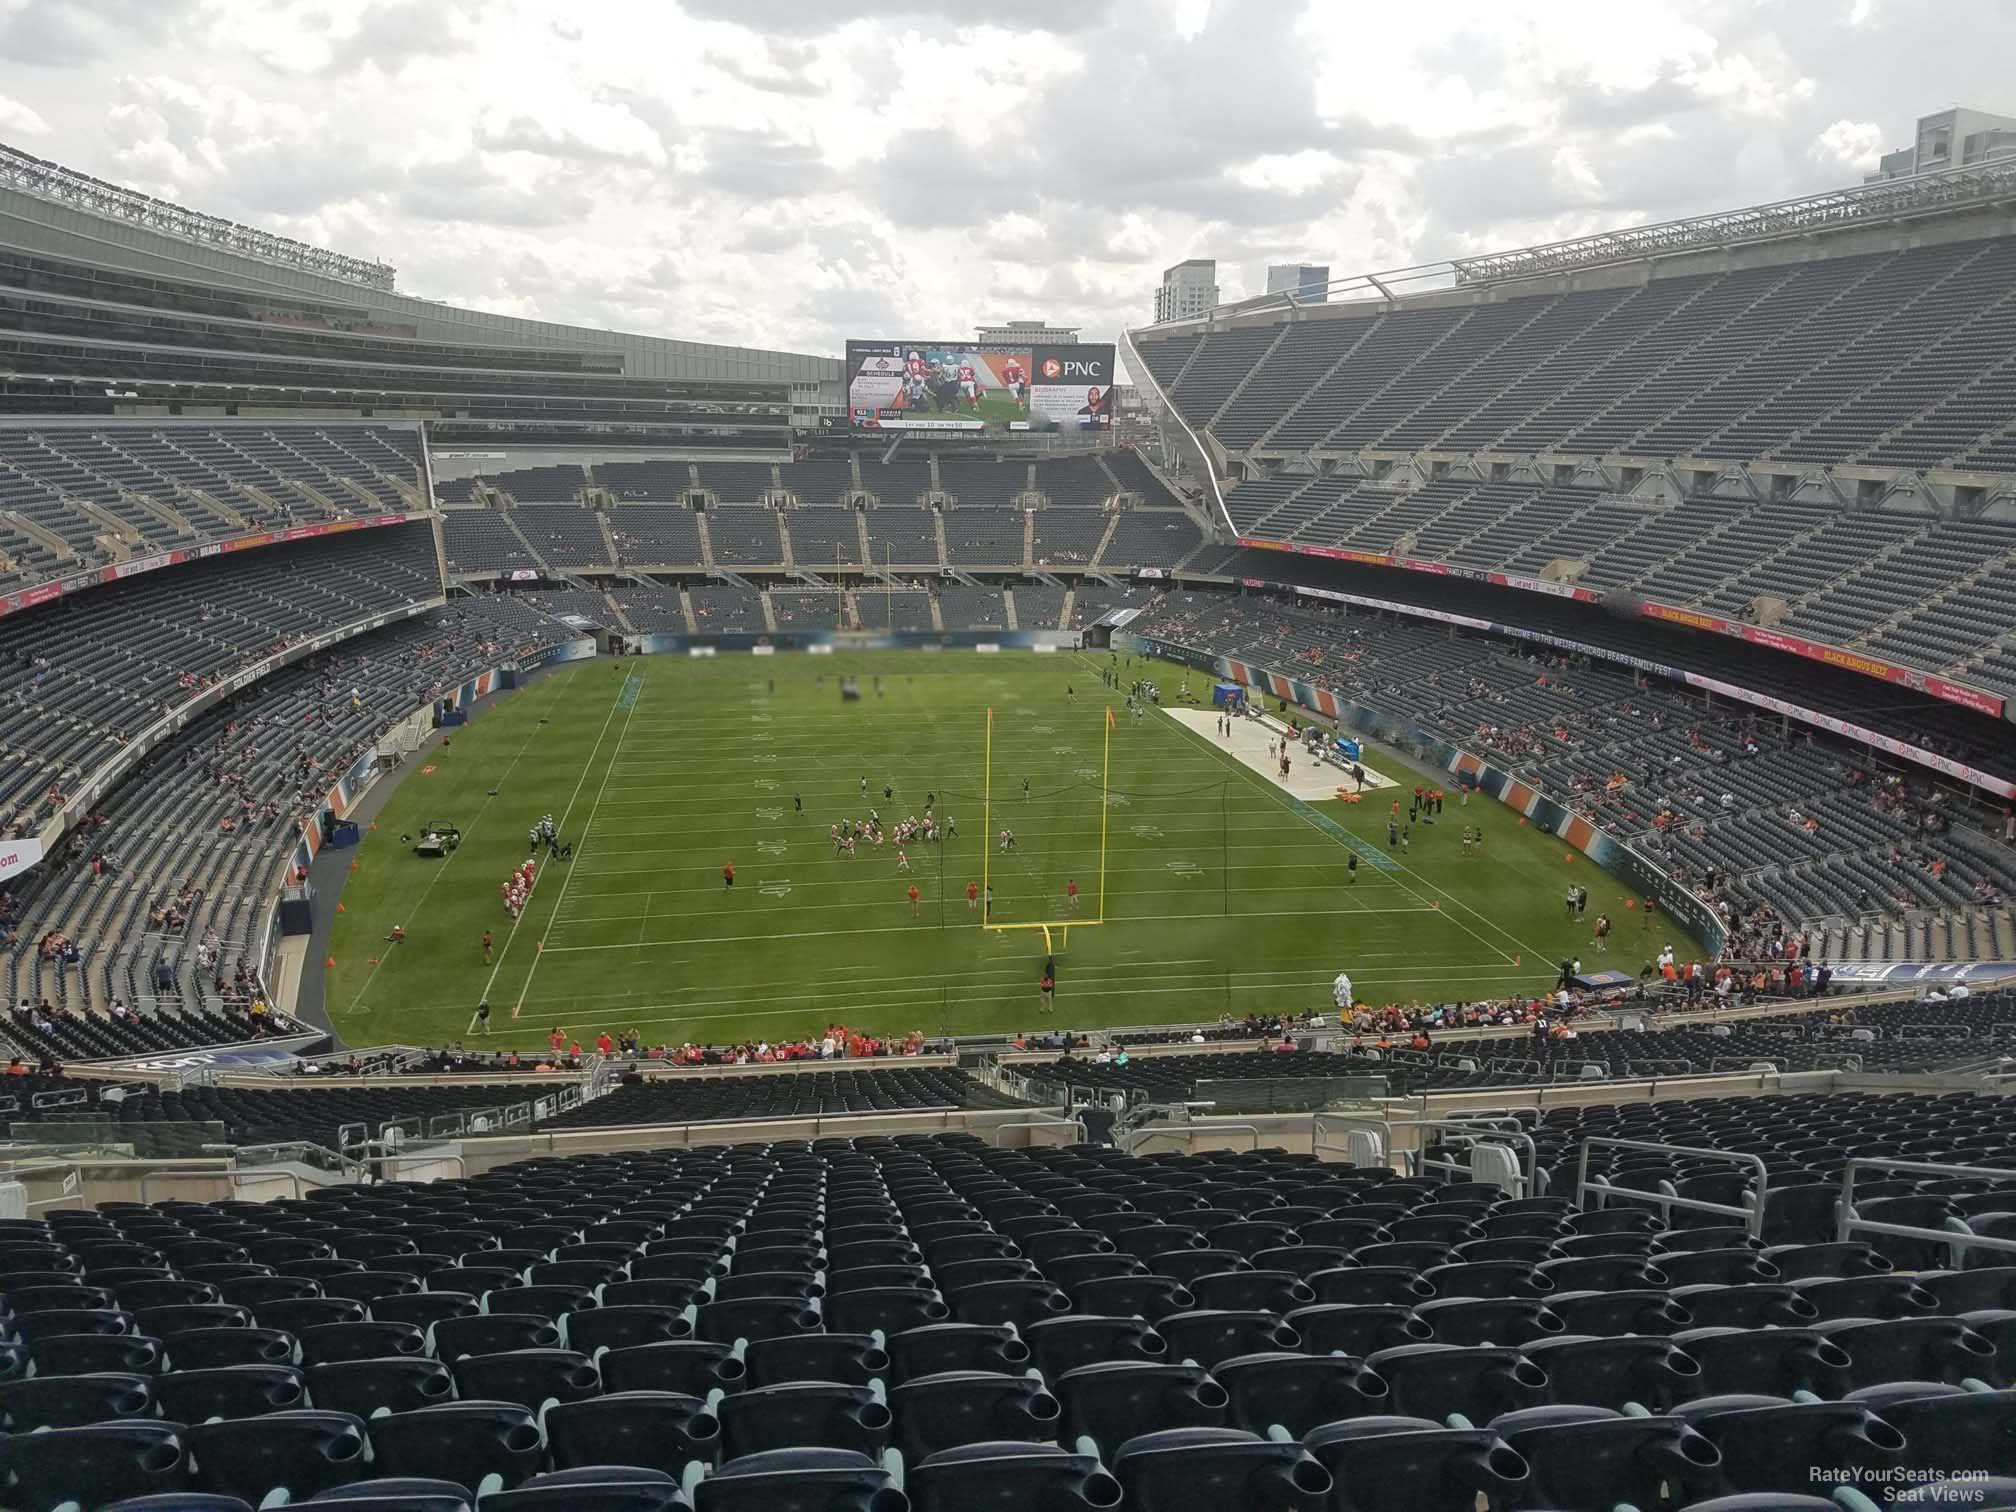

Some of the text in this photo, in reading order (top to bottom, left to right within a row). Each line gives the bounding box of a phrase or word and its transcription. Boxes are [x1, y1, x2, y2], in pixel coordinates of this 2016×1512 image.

[1063, 361, 1101, 376] PNC
[1503, 626, 1531, 639] WELCOME
[1532, 631, 1540, 641] TO
[1541, 634, 1553, 645] THE
[1577, 643, 1606, 658] CHICAGO
[1607, 650, 1629, 664] BEARS
[1630, 656, 1653, 671] FAMILY
[1655, 663, 1672, 677] FEST
[1824, 650, 1888, 676] BLACK ANGUS BEEF
[233, 663, 271, 690] SOLDIER FIELD
[1848, 727, 1861, 738] PNC
[1876, 735, 1890, 748] PNC
[1906, 746, 1921, 760] PNC
[1937, 758, 1952, 770] PNC
[1970, 771, 1985, 785] PNC
